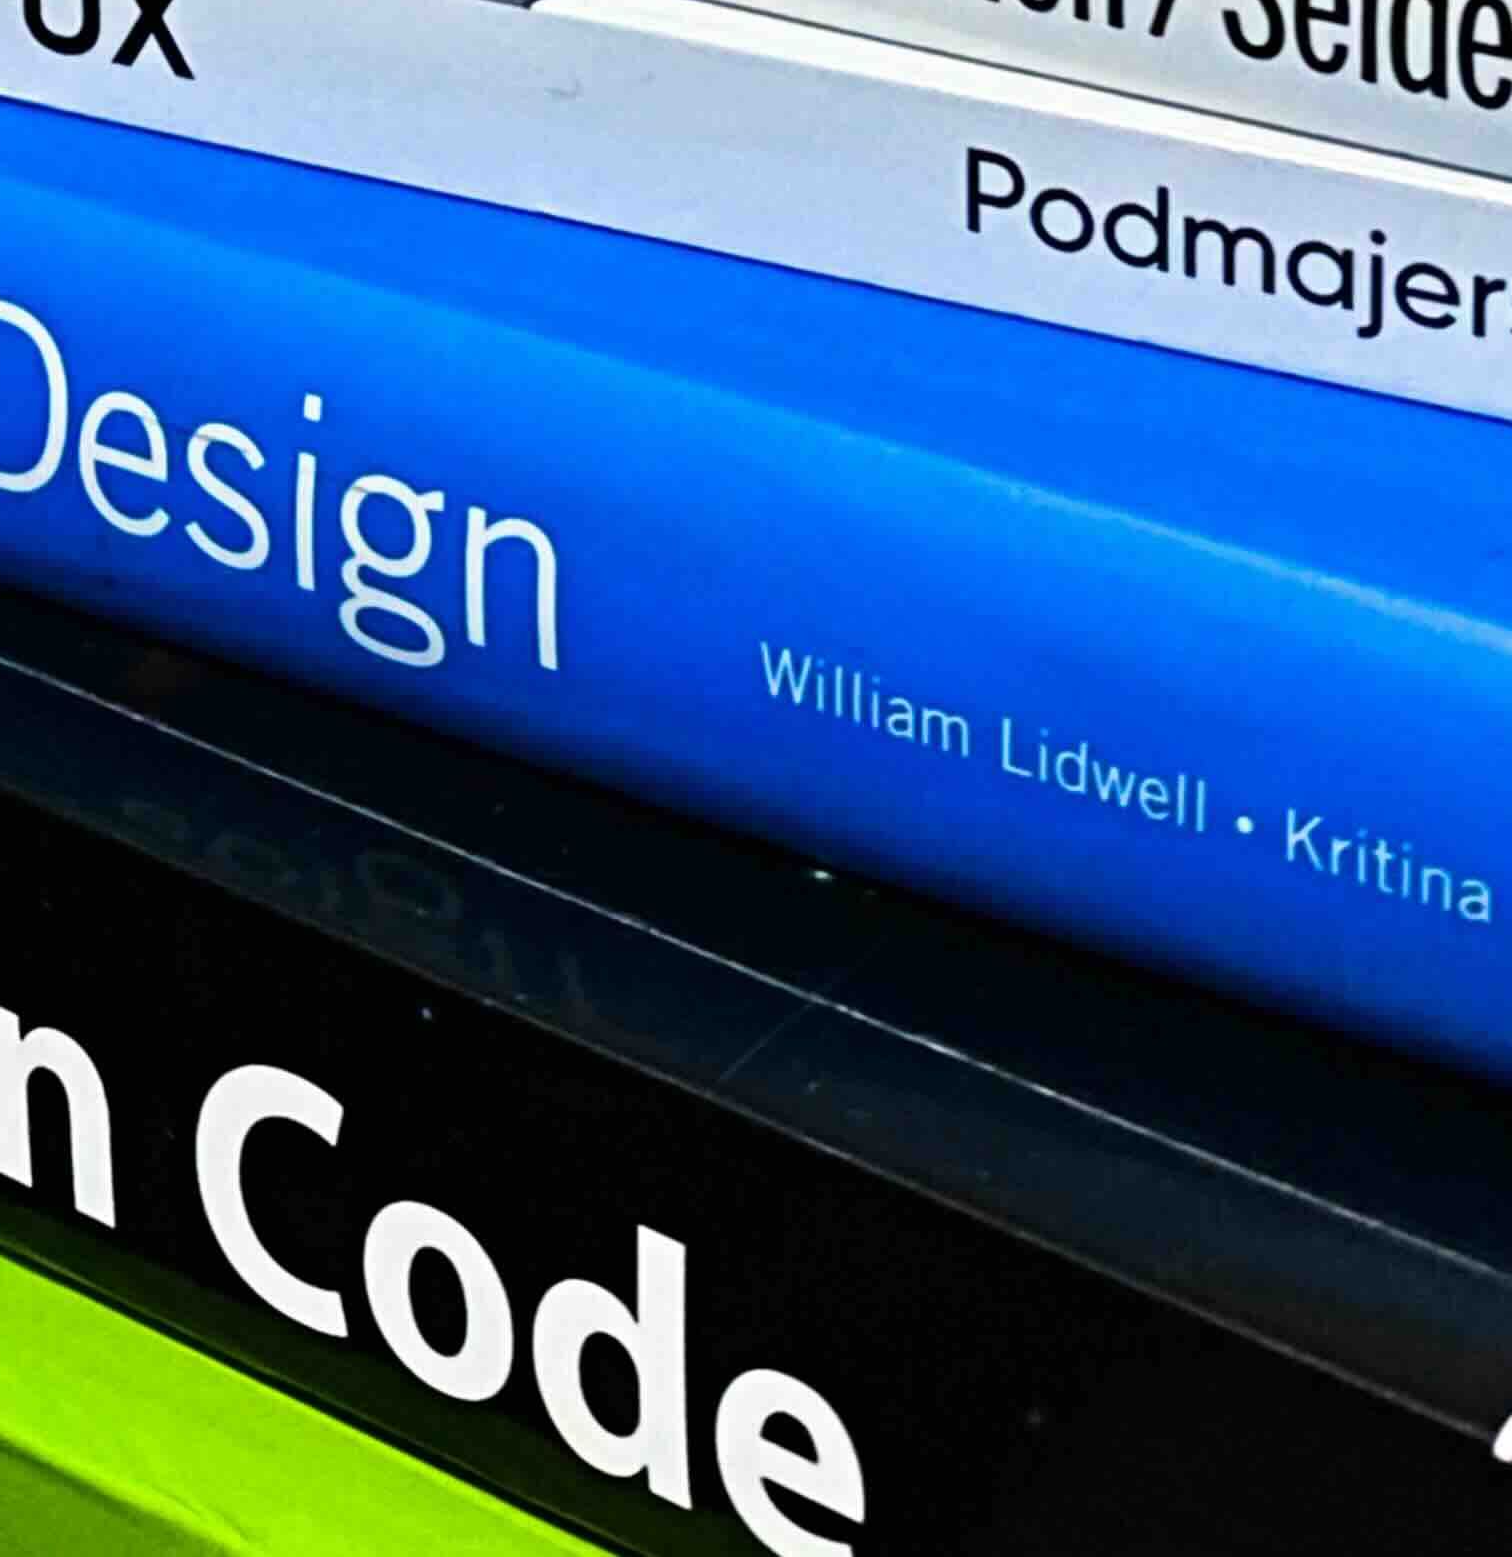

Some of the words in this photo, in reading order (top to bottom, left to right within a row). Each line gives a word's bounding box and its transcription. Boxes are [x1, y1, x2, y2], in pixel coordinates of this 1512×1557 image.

[760, 638, 972, 758] William
[998, 716, 1208, 835] Lidwell
[1282, 806, 1495, 925] Kritina
[194, 1063, 868, 1557] Code
